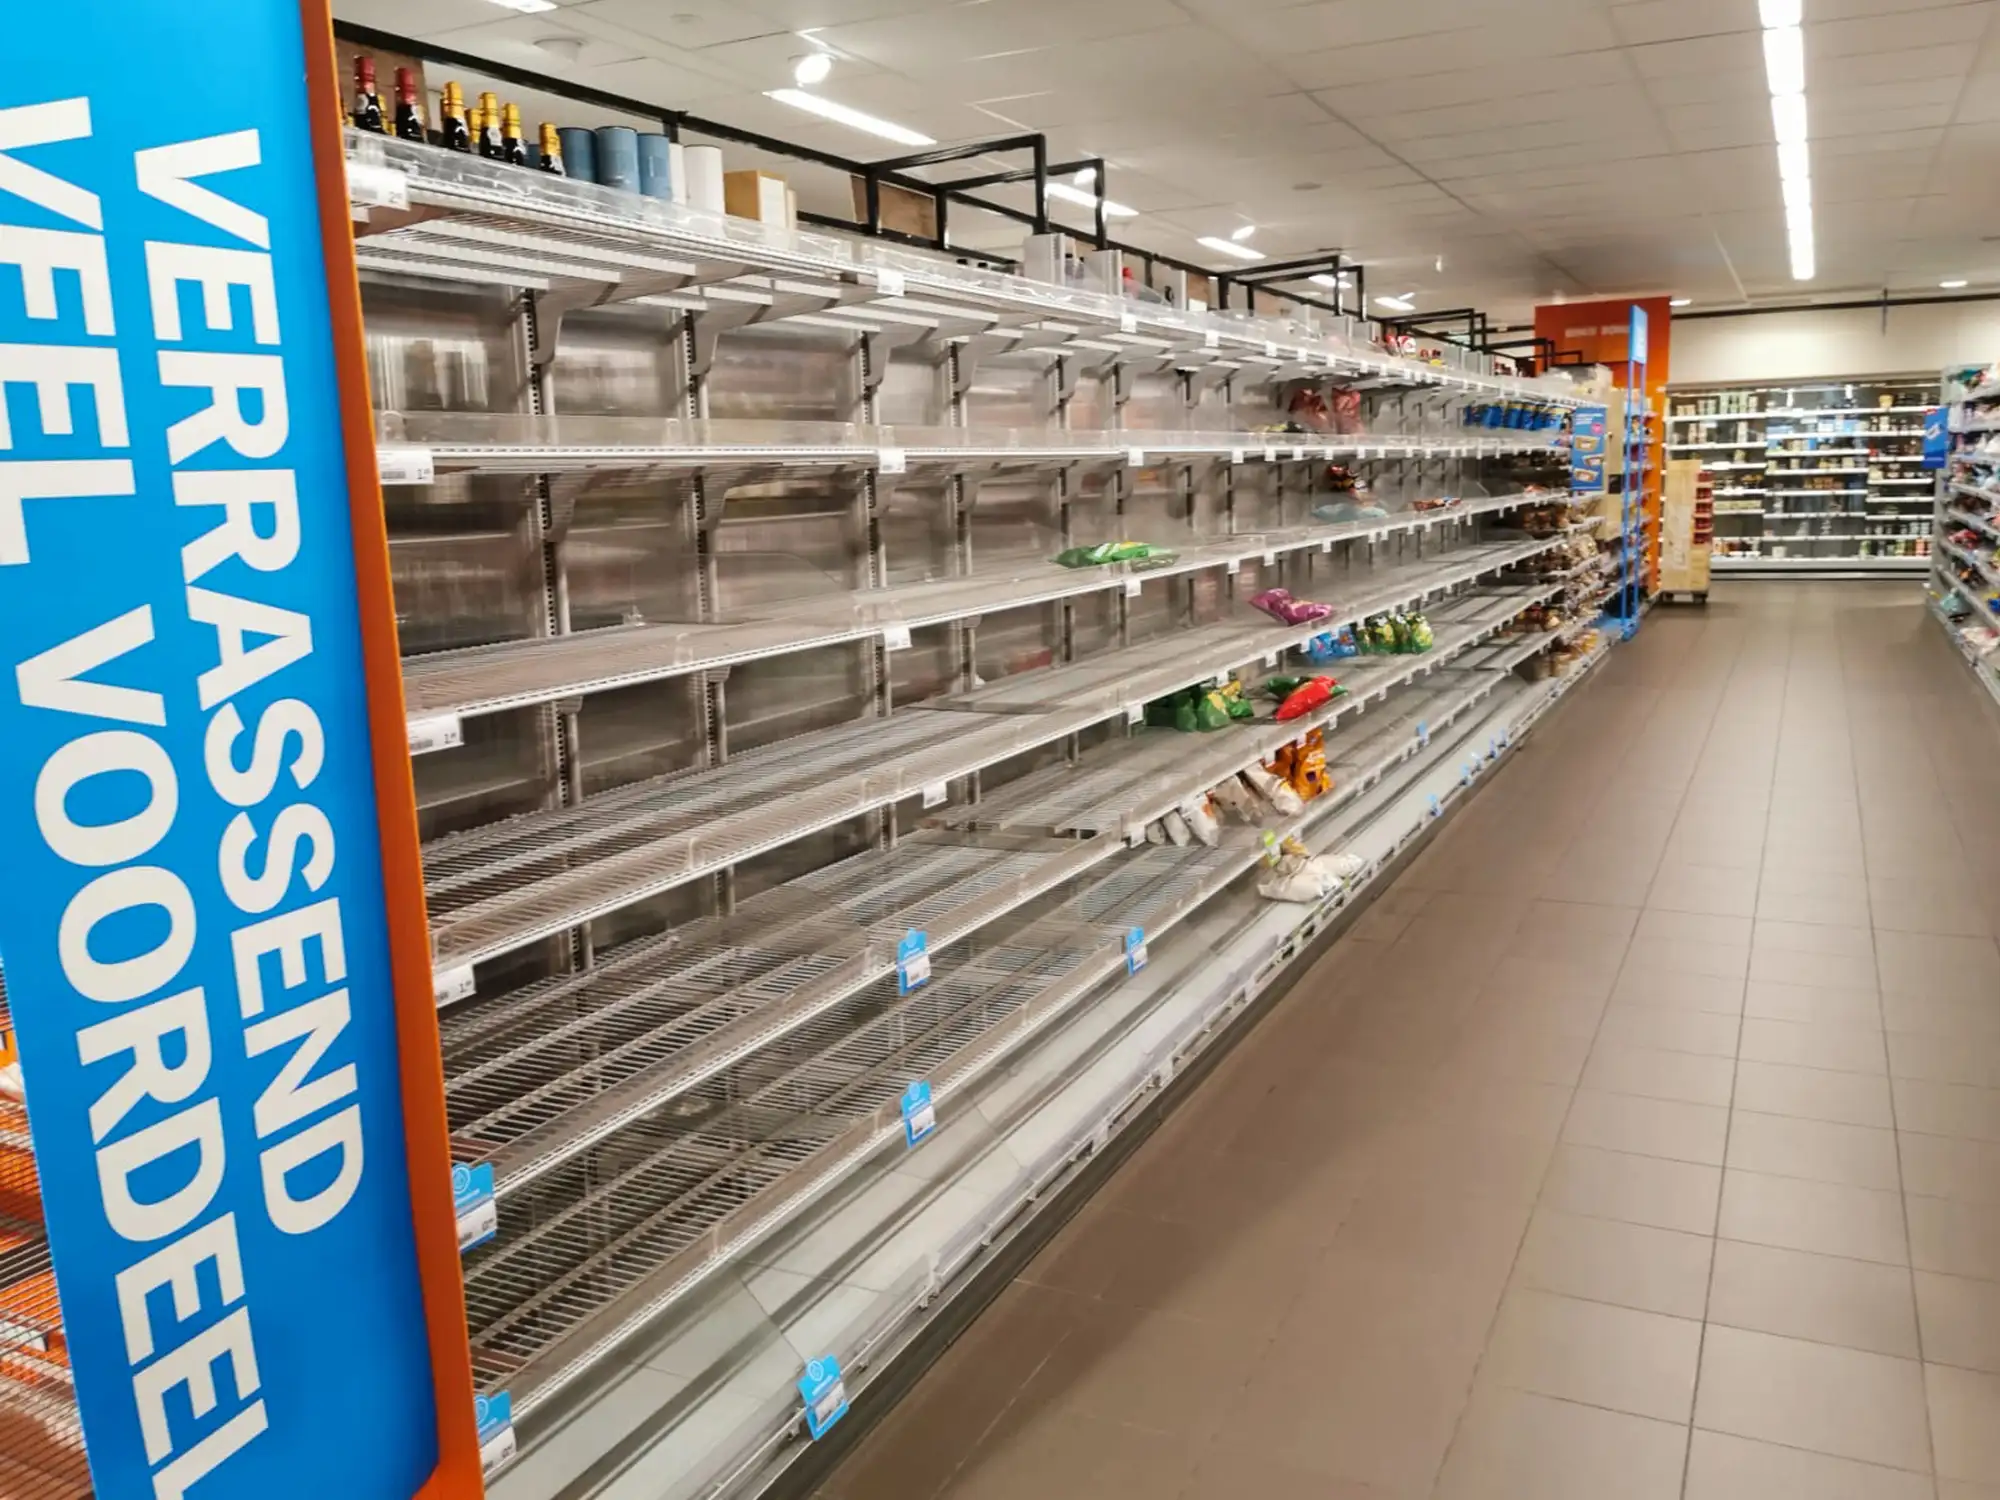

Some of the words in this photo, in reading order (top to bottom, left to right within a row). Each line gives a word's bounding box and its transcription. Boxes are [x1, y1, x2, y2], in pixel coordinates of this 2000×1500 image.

[0, 97, 135, 565] VEEL
[136, 129, 364, 1235] VERRASSEND
[17, 605, 269, 1500] VOORDEEL
